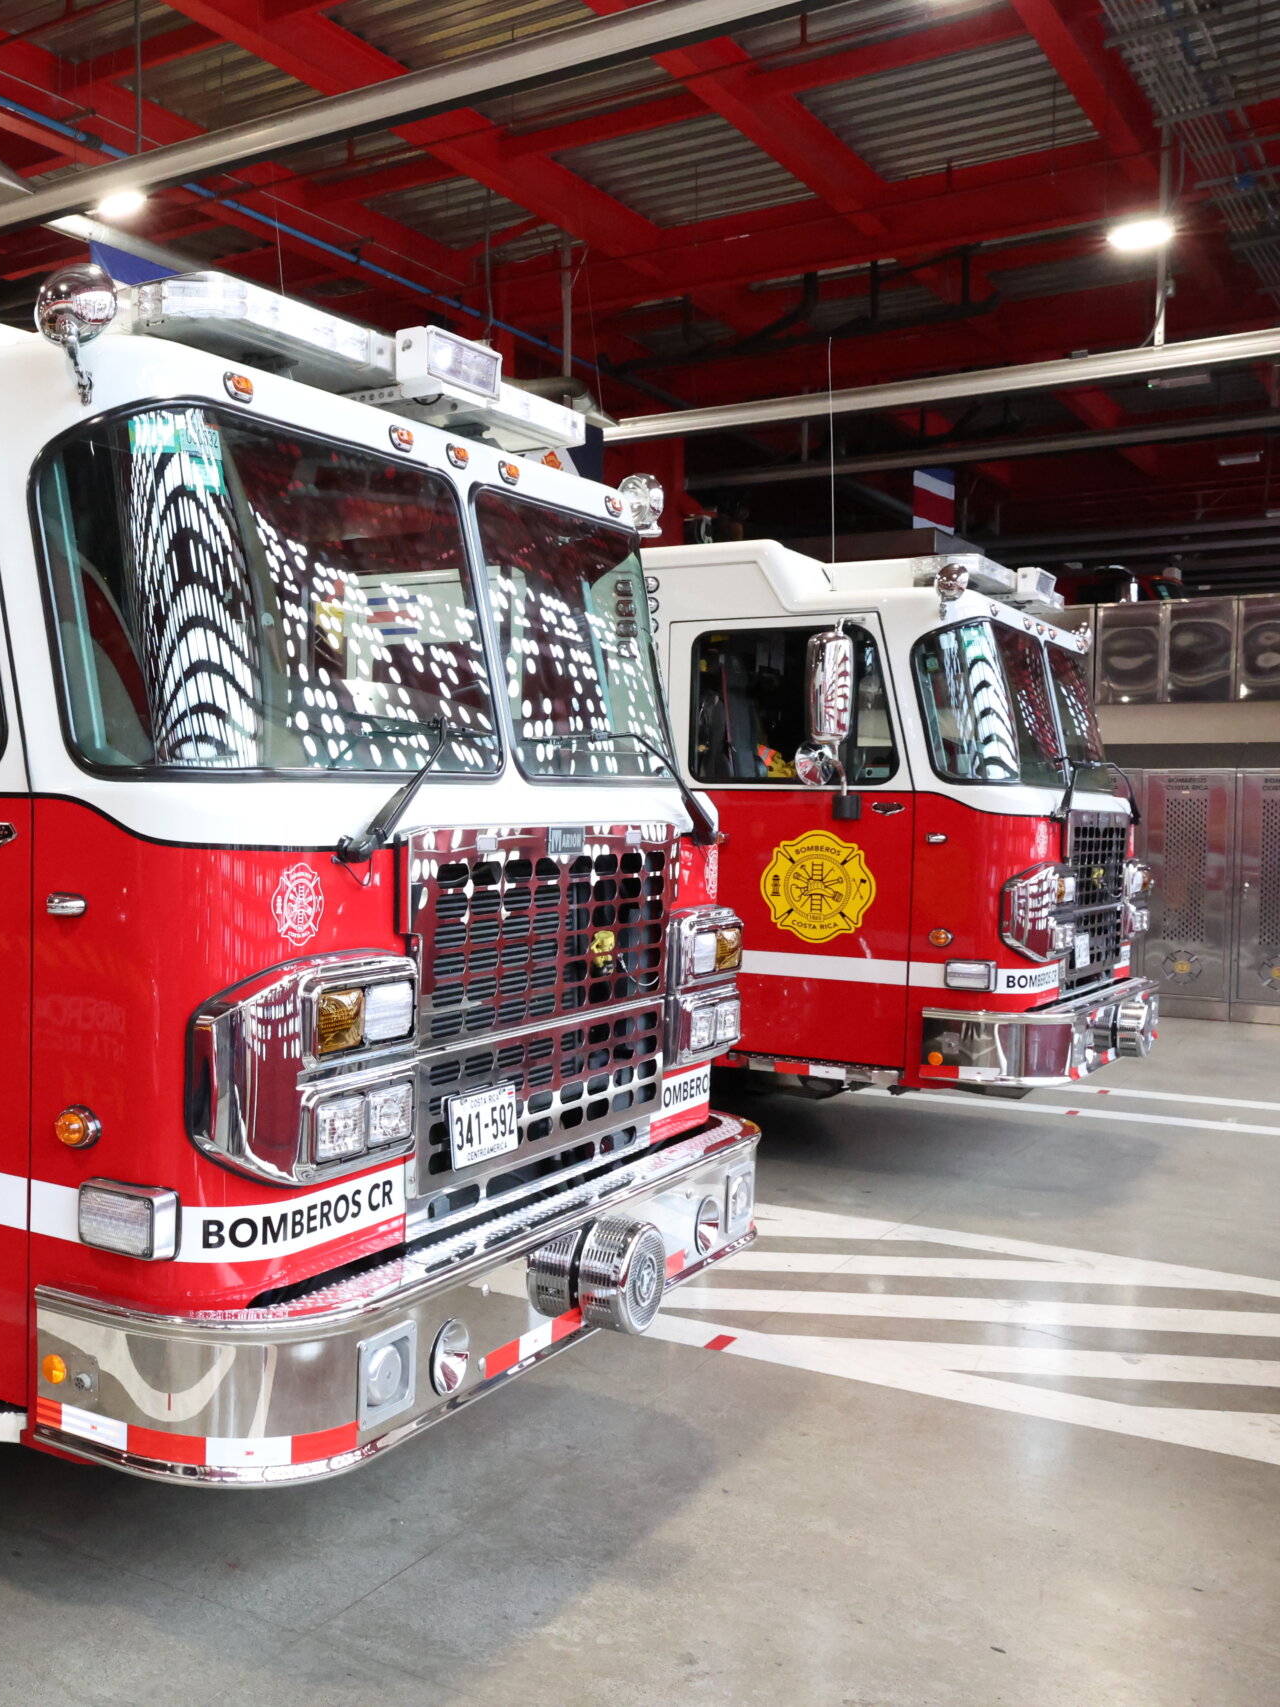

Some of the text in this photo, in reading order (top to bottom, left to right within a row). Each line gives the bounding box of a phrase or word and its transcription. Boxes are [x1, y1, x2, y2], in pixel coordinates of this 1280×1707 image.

[551, 829, 582, 852] MARION
[795, 845, 842, 857] BOMBEROS
[791, 919, 839, 930] COSTA RICA
[470, 1094, 499, 1108] COSTA RICA
[455, 1102, 515, 1151] 341-592
[467, 1142, 508, 1162] CENTROAMERICA
[202, 1180, 394, 1249] BOMBEROS CR
